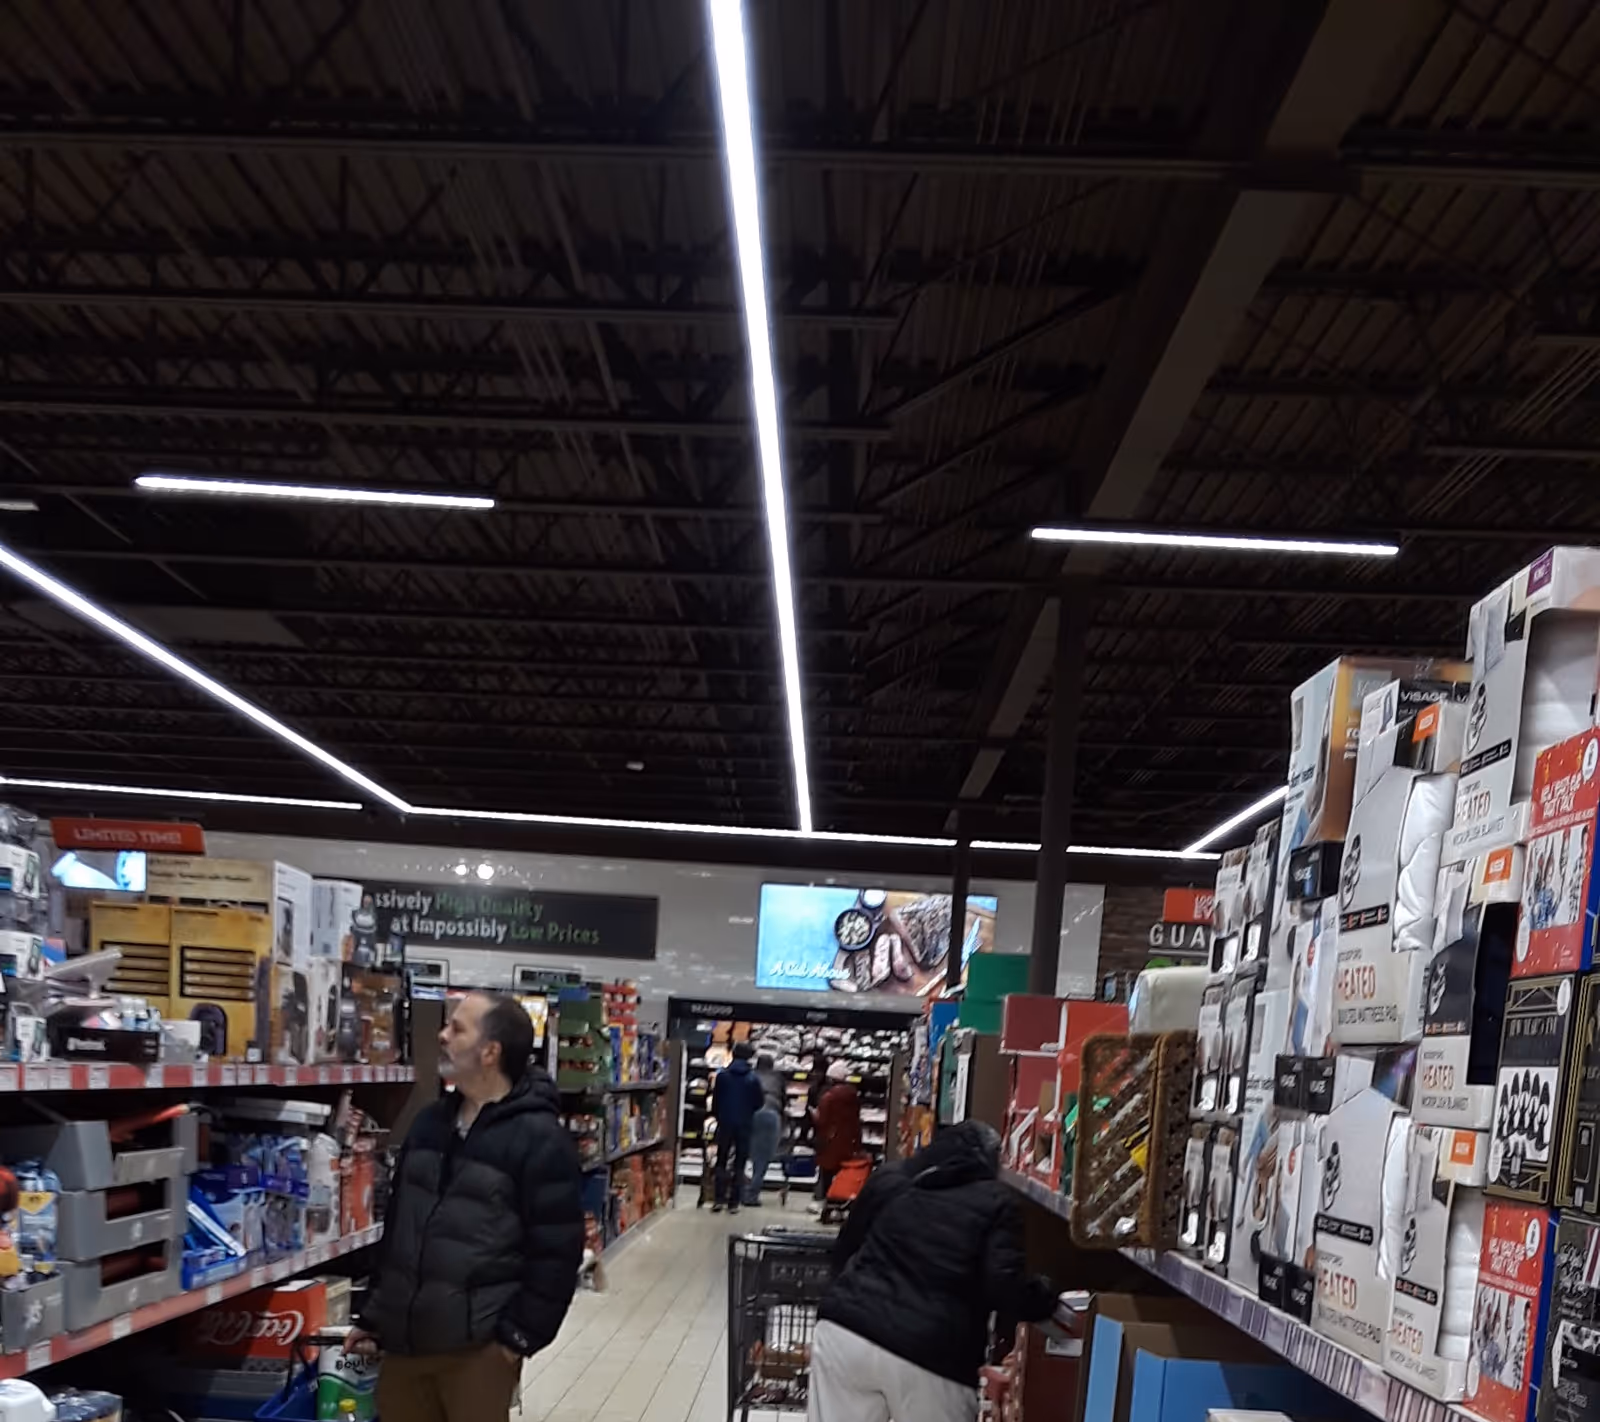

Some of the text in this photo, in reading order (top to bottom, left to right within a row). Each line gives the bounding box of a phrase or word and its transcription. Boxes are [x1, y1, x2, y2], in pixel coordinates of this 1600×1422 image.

[435, 891, 475, 918] High
[479, 893, 543, 922] Quality
[390, 914, 601, 946] at Impossibly Low Prices
